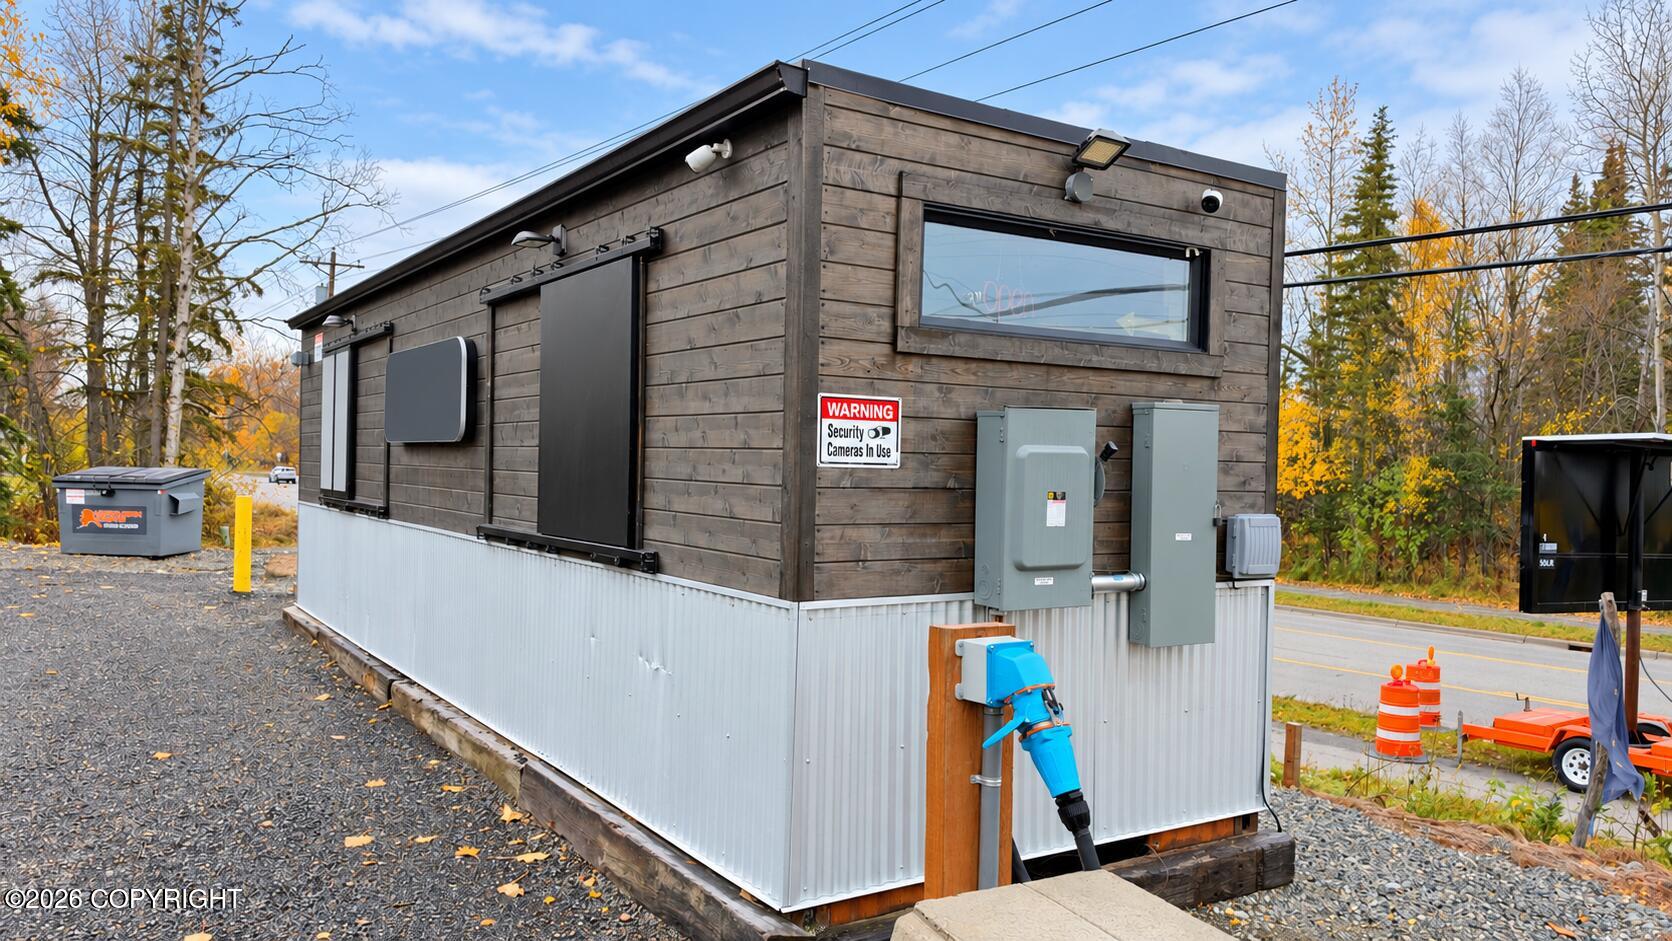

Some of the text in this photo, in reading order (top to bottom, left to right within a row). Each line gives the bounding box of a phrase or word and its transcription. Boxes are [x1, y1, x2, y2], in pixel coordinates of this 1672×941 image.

[827, 401, 894, 419] WARNING
[827, 423, 865, 442] Security
[827, 442, 892, 458] Cameras In Use
